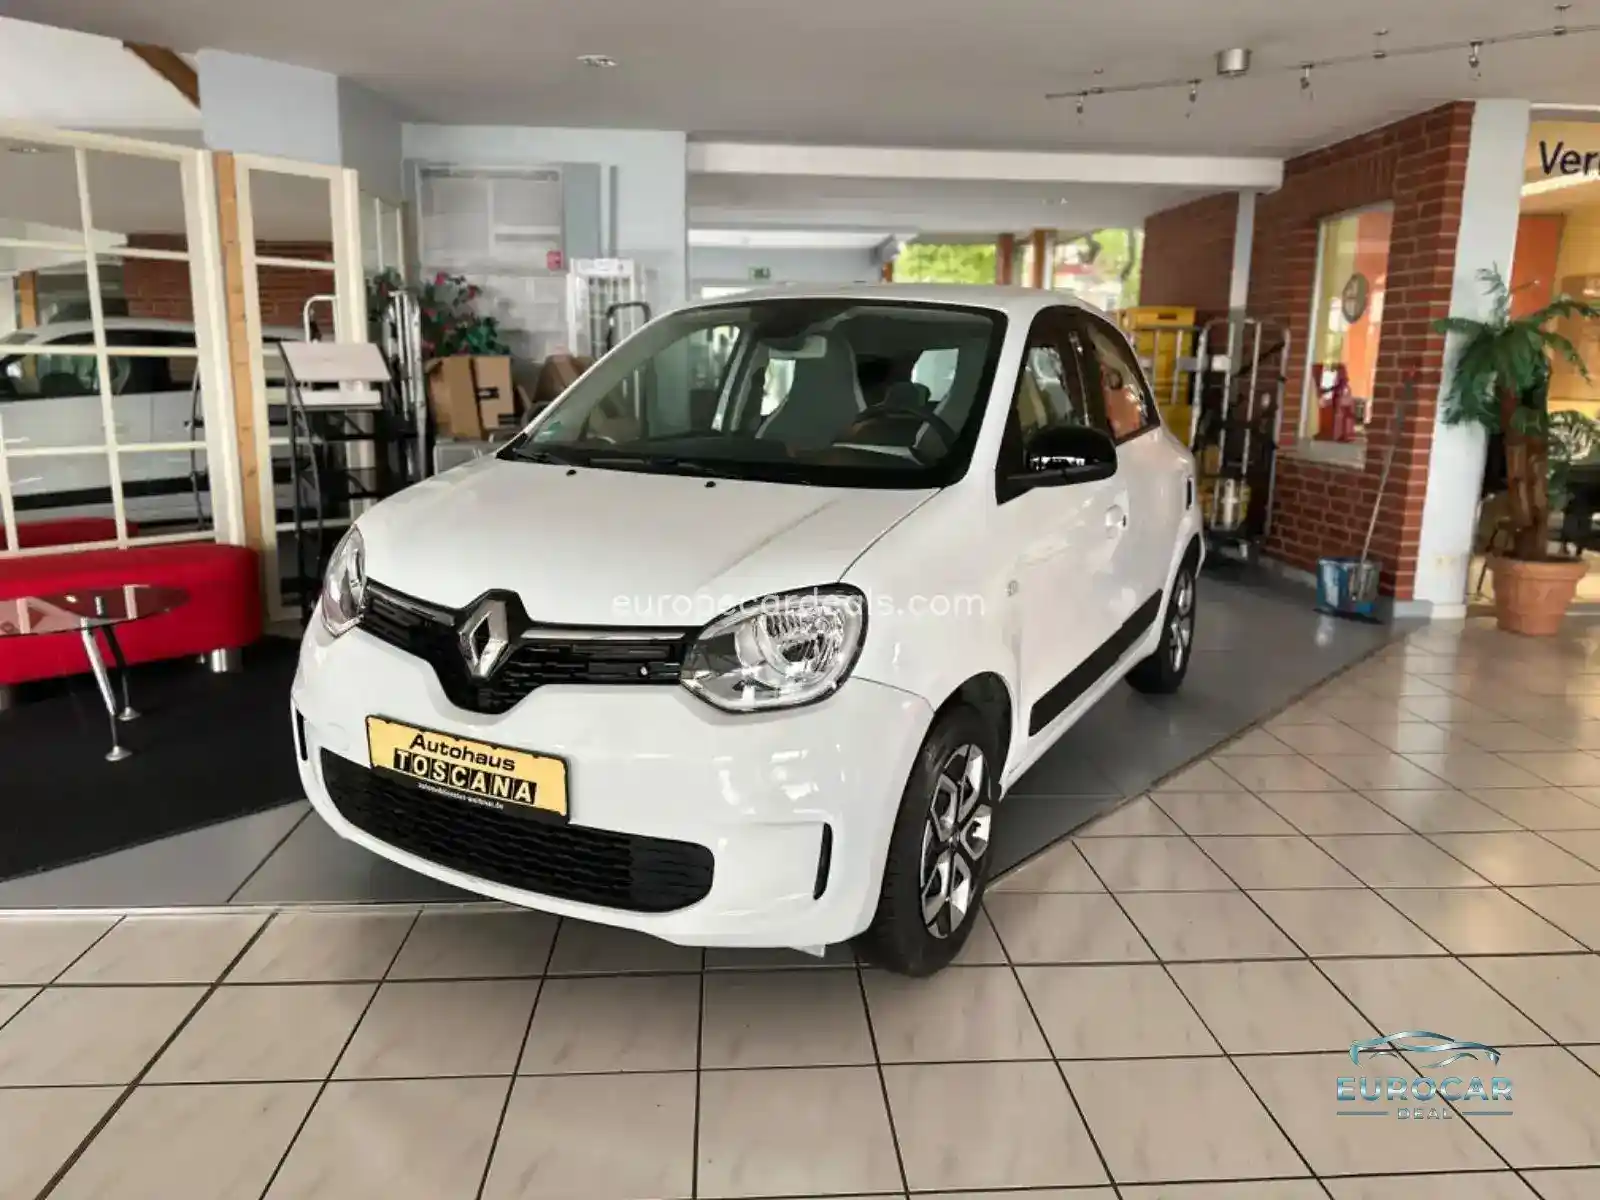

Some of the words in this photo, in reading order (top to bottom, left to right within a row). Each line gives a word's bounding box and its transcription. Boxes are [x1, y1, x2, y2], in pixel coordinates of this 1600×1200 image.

[1539, 140, 1600, 176] Ver
[409, 734, 516, 771] Autohaus
[395, 749, 536, 804] TOSCANA
